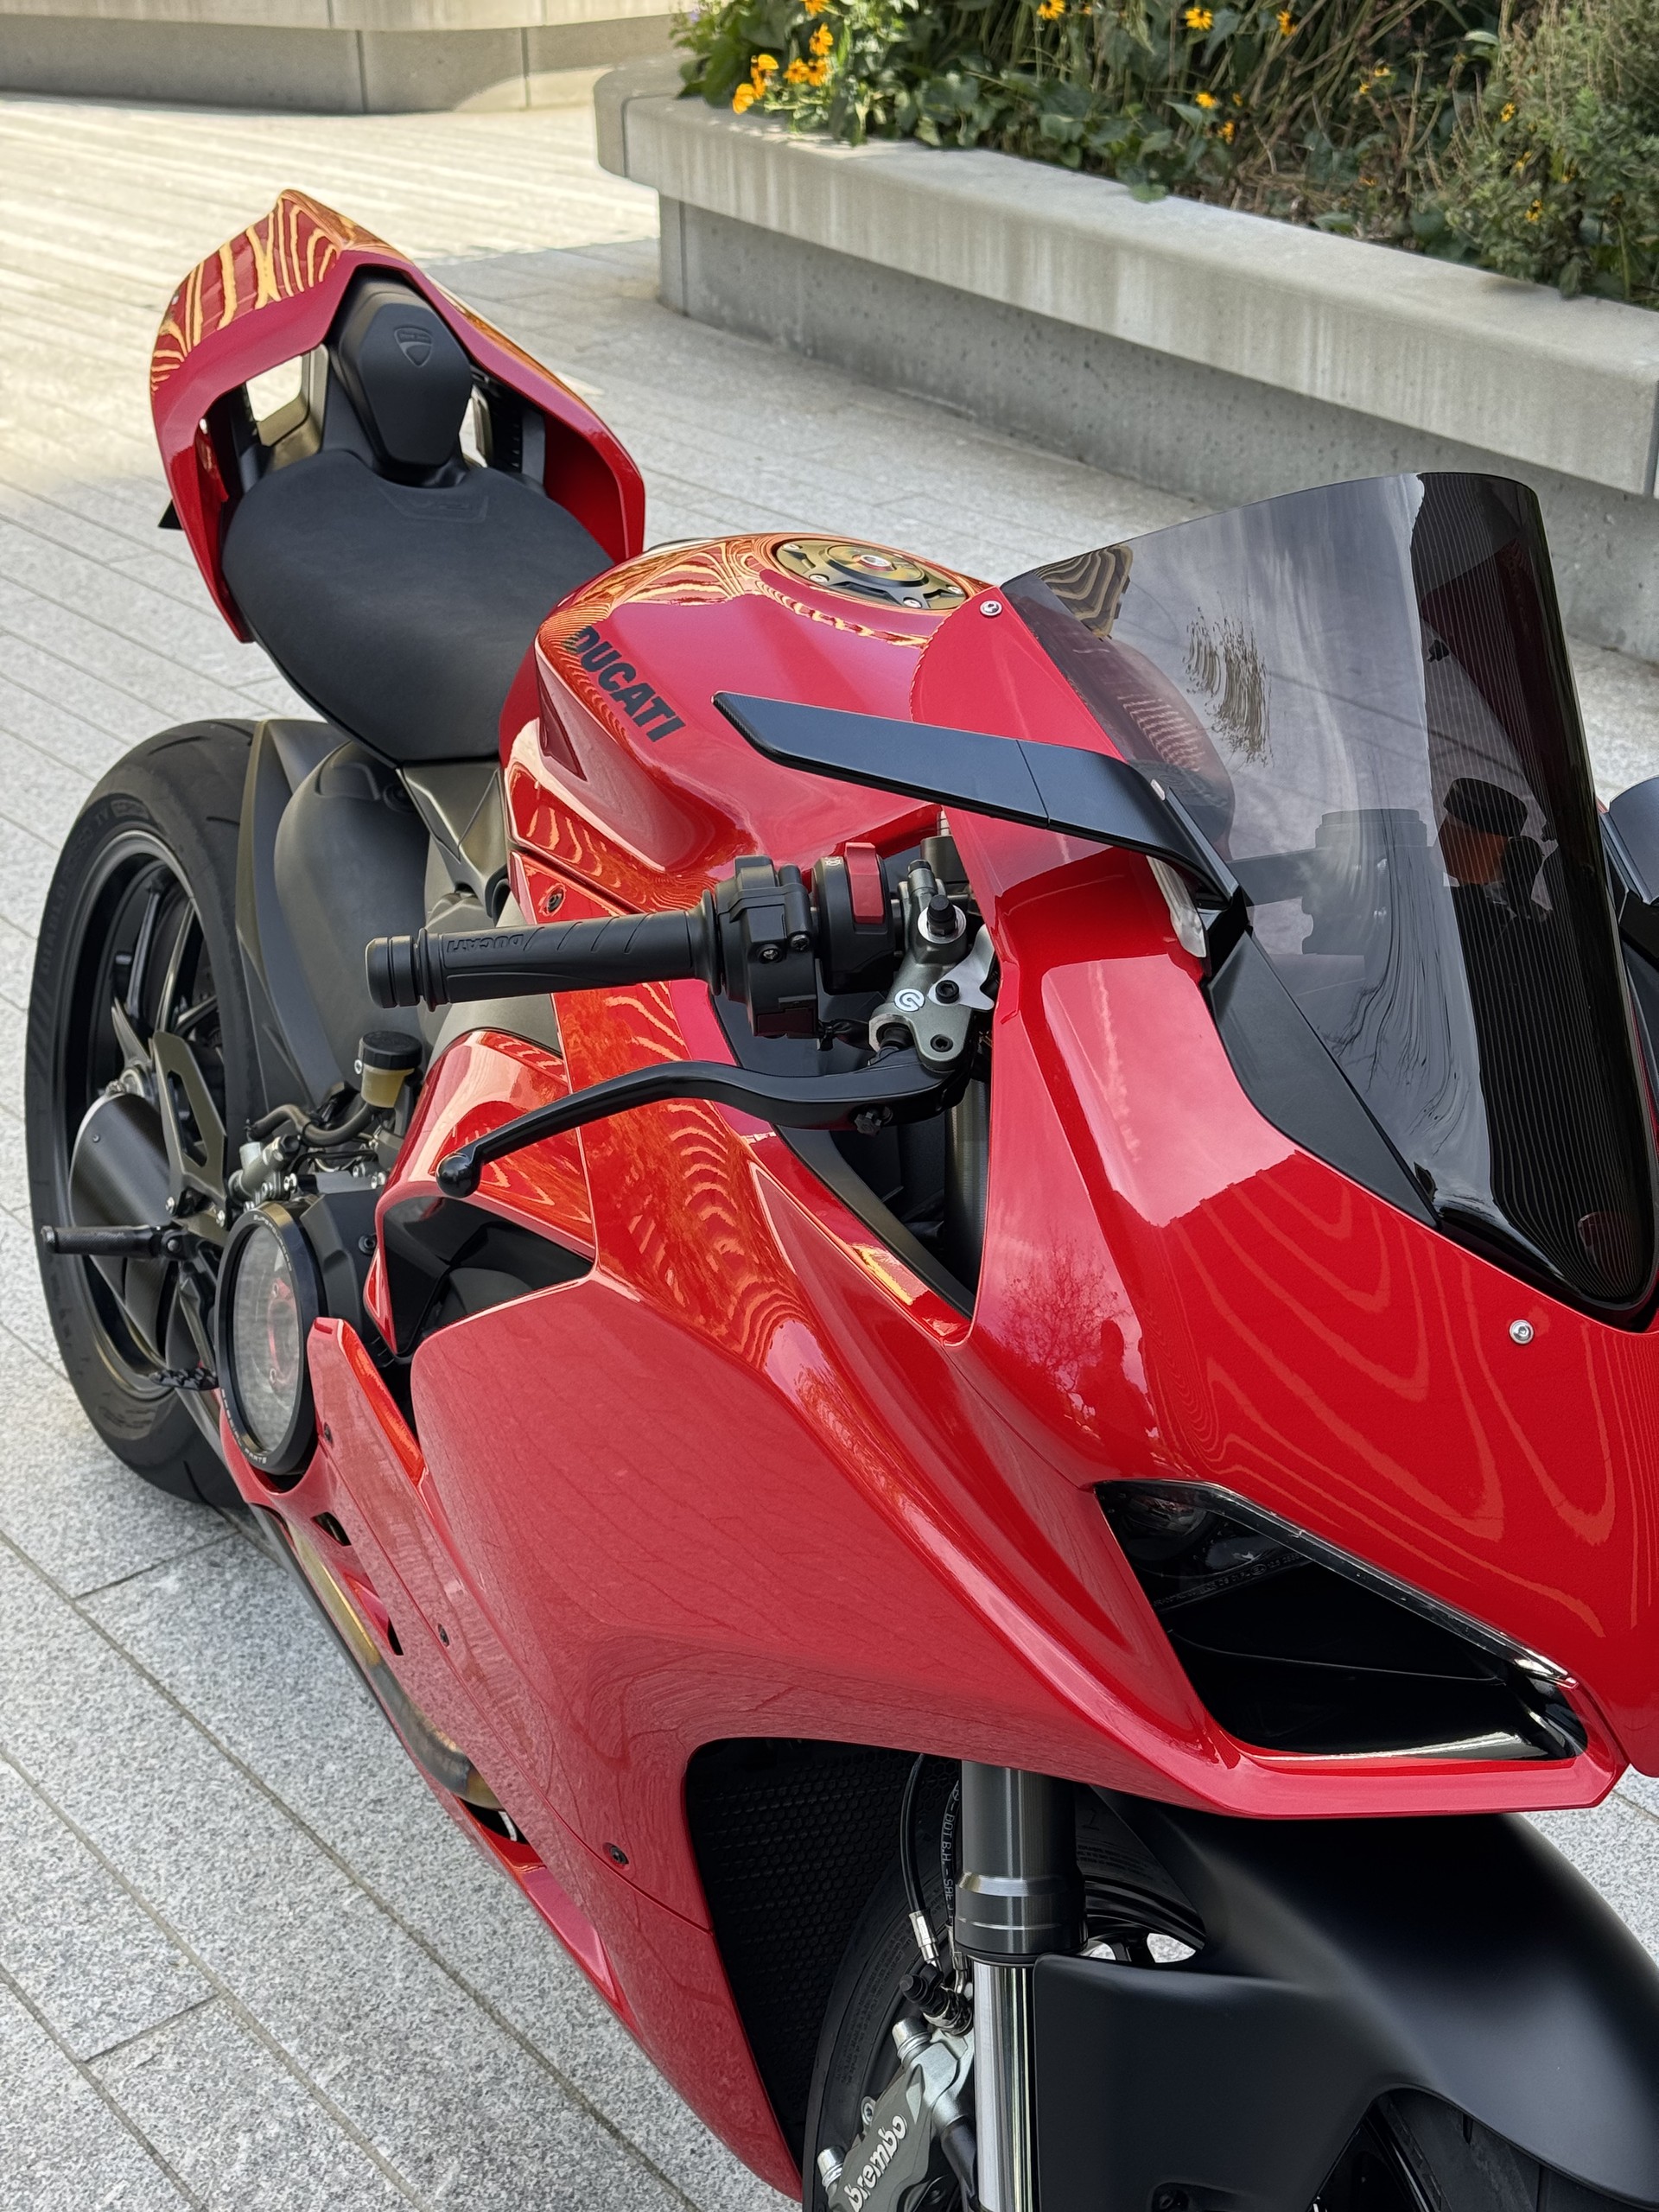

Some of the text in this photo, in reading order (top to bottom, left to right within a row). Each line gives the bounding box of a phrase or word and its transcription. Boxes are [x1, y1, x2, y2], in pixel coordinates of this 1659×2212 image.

[563, 625, 686, 742] DUCATI
[446, 933, 524, 953] DUCATI
[244, 1448, 267, 1465] PARTS
[943, 1813, 956, 1839] DOT
[943, 1878, 955, 1901] SAE
[843, 2114, 907, 2212] brembo
